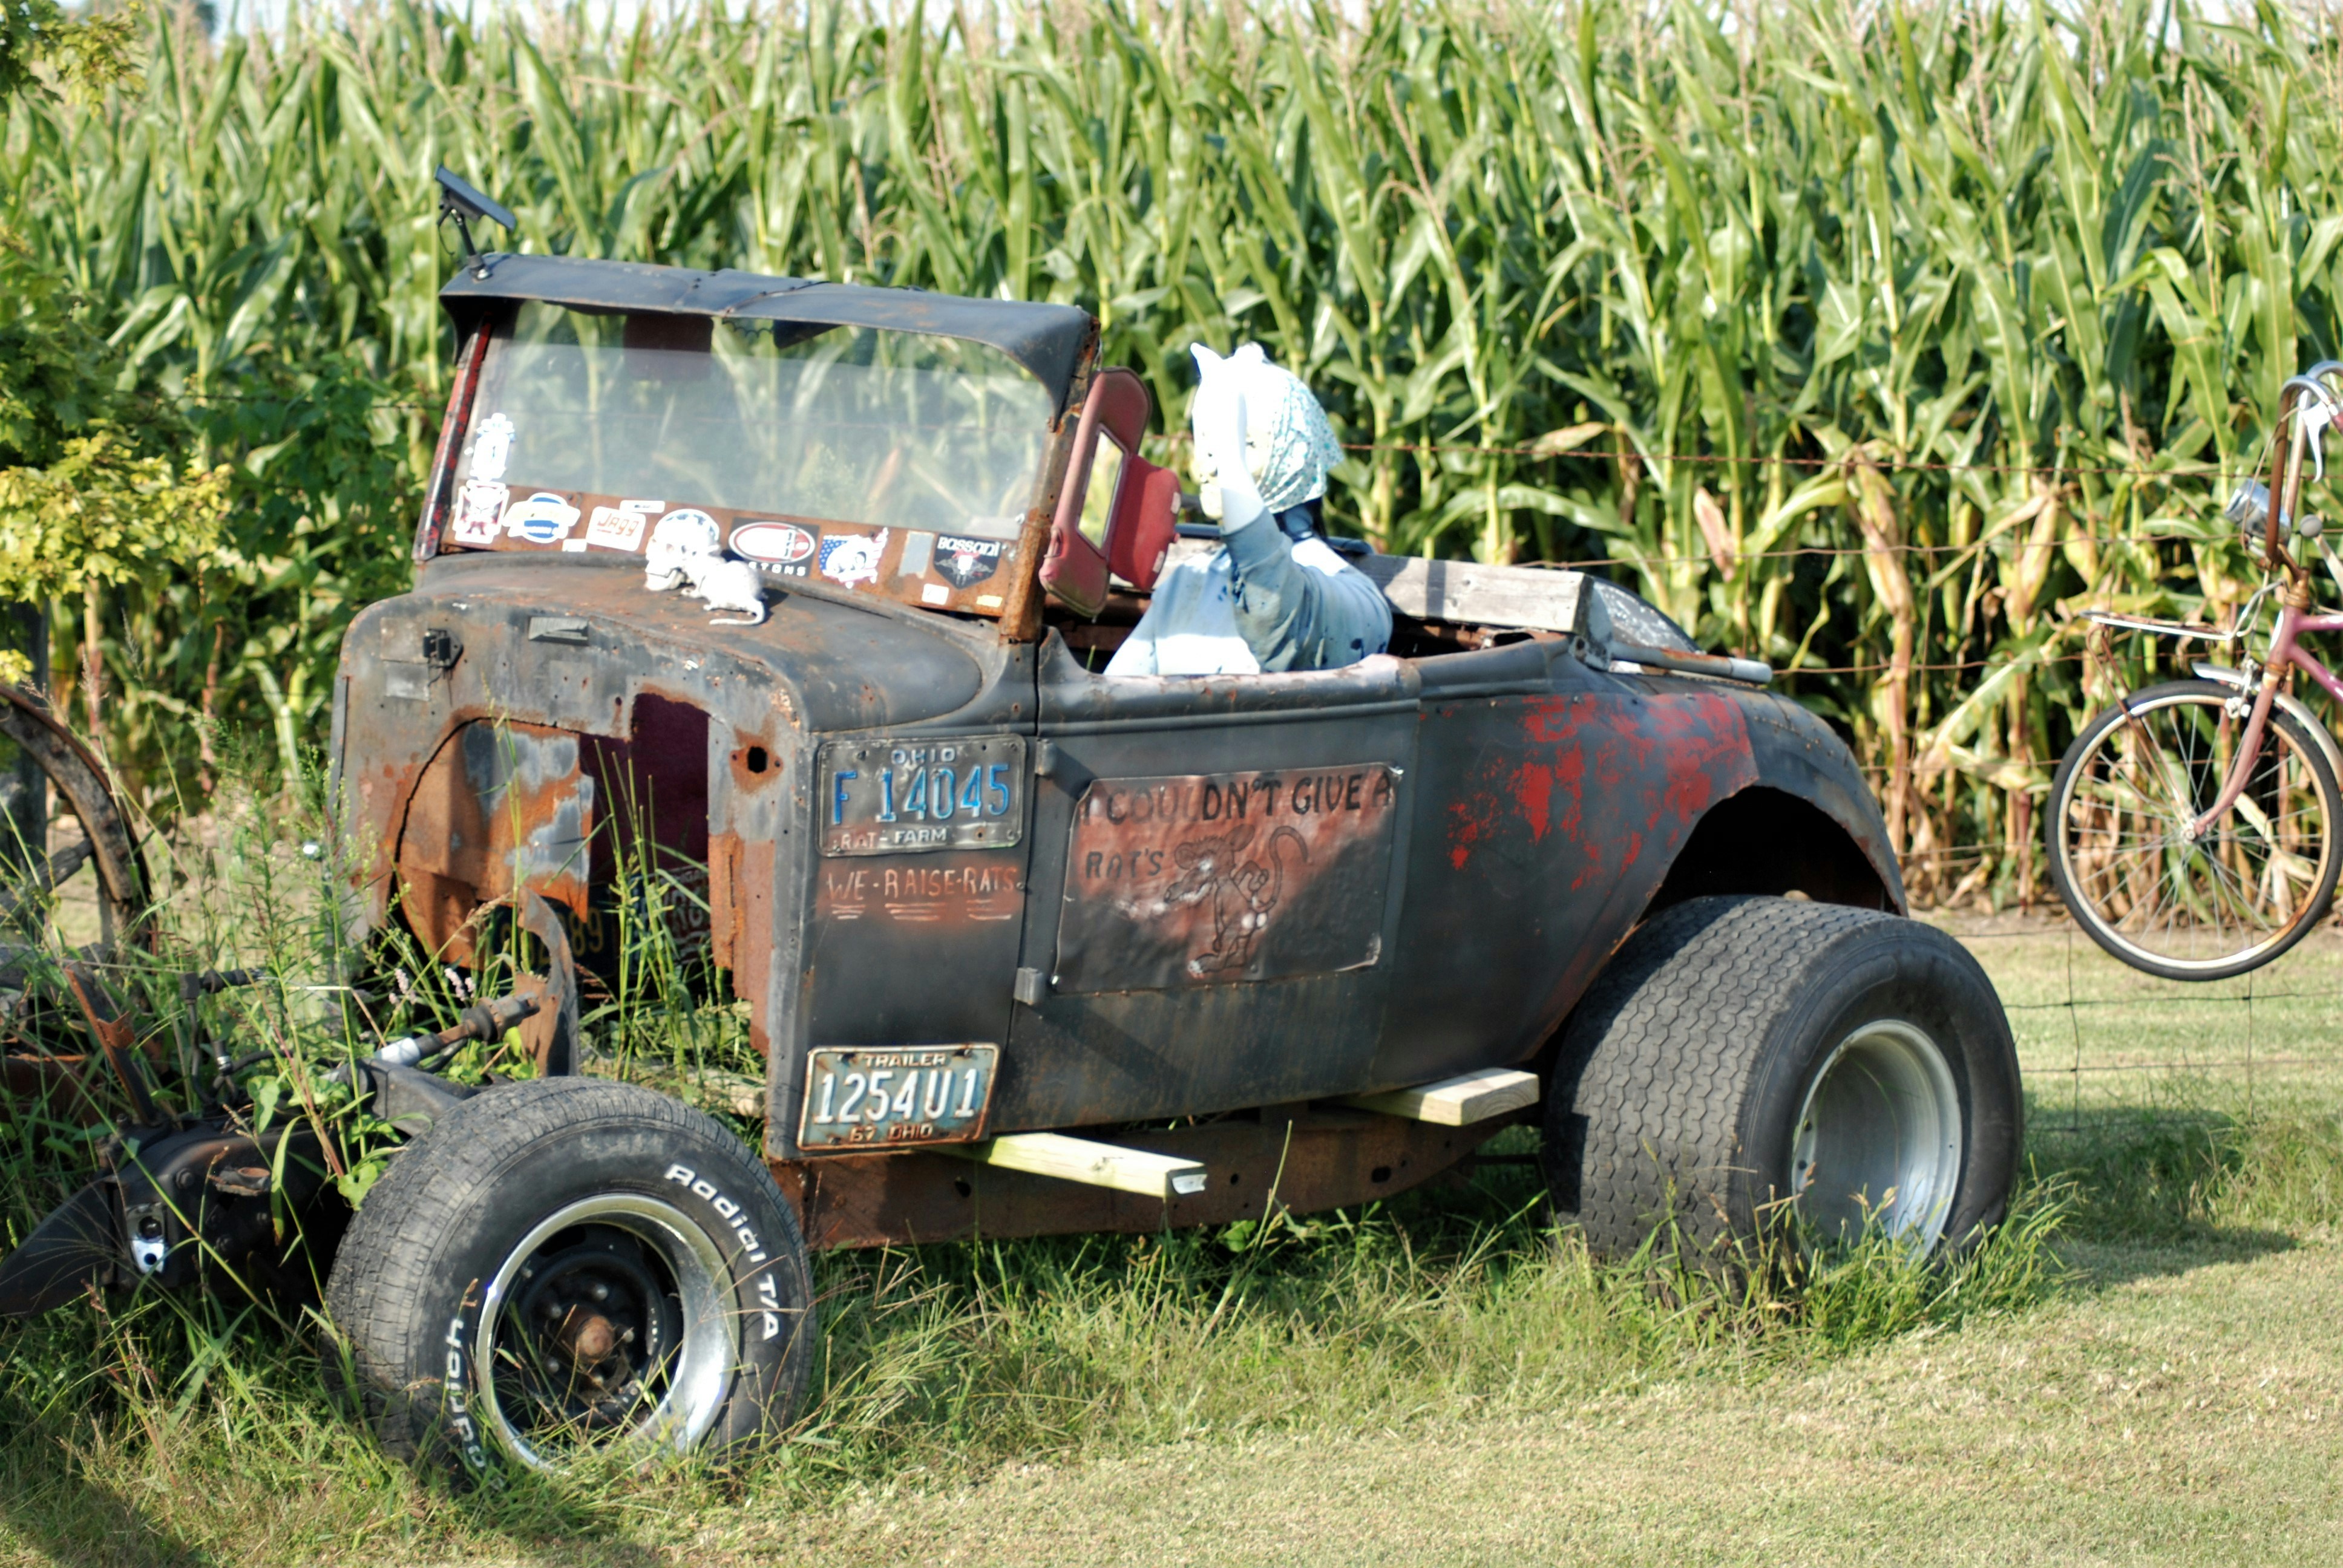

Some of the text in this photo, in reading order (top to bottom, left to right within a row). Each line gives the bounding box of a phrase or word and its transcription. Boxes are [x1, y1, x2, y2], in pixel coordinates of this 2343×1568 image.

[891, 747, 956, 765] OHIO
[1106, 778, 1282, 826] COULDN'T
[1291, 773, 1363, 815] GIVE
[1371, 771, 1391, 808] A
[1086, 848, 1164, 879] RAT'S
[863, 1053, 947, 1068] TRAILER
[850, 1122, 933, 1143] 67 OHIO
[664, 1163, 780, 1341] Radial T/A
